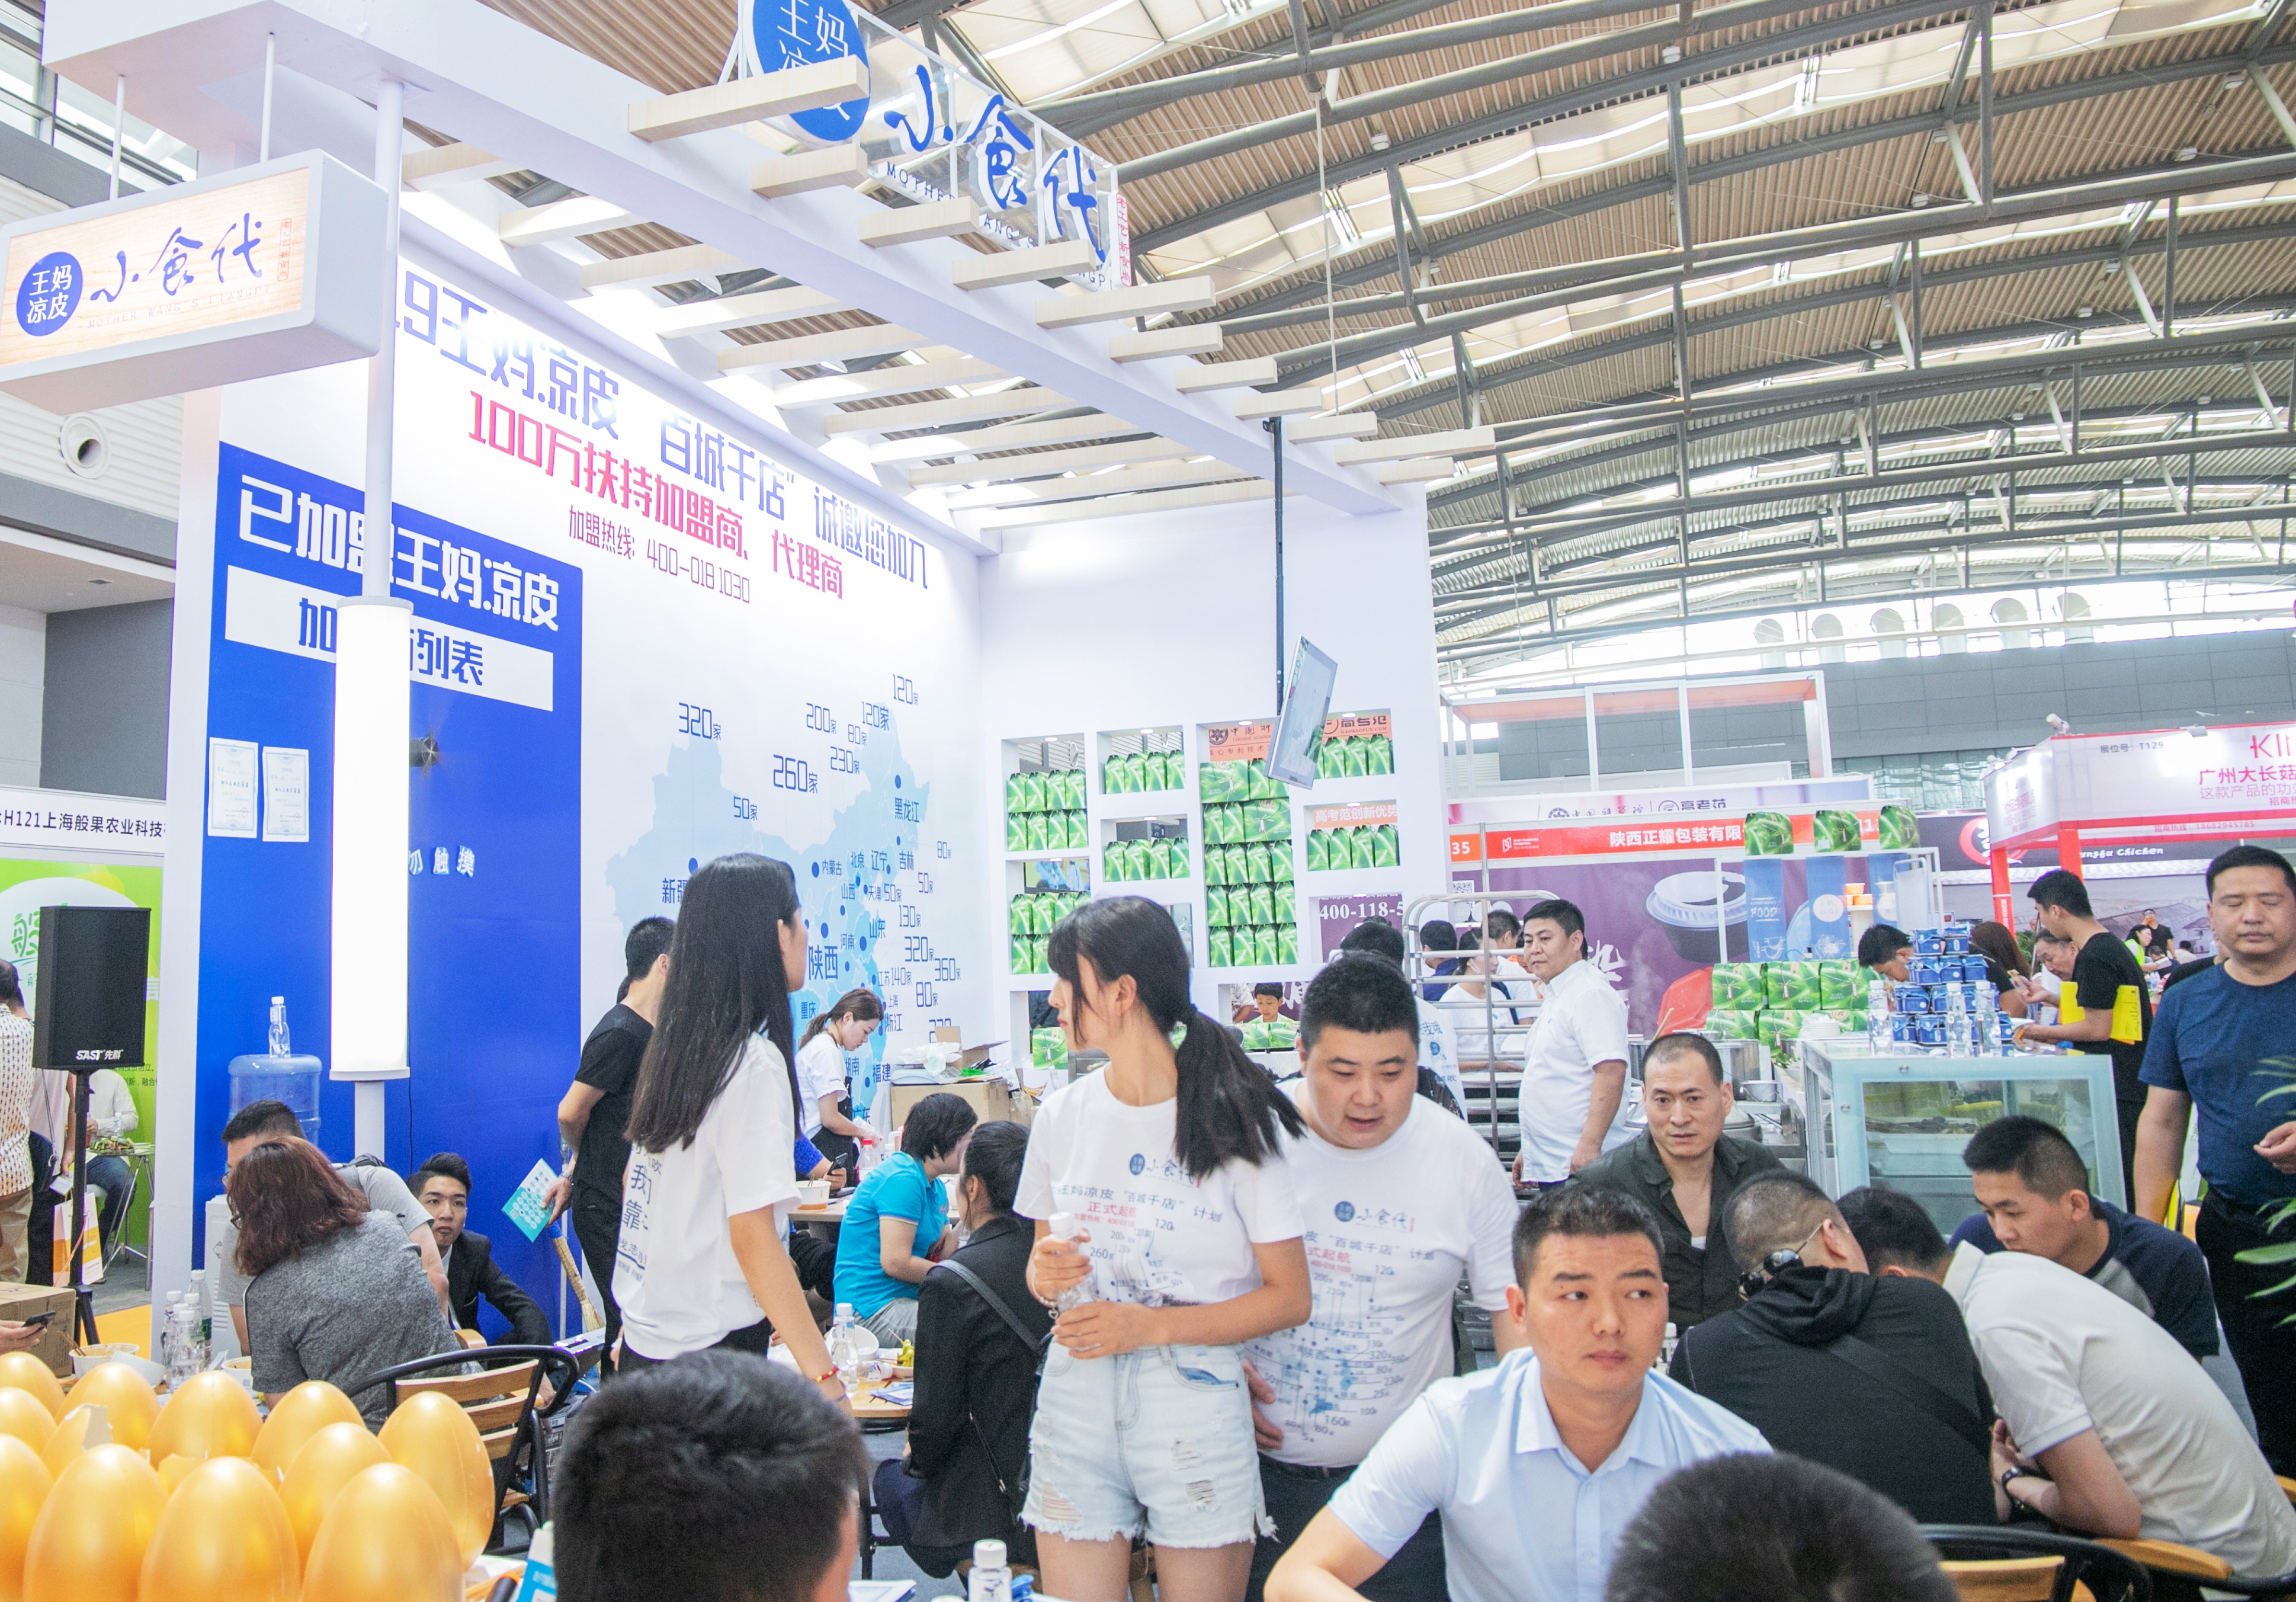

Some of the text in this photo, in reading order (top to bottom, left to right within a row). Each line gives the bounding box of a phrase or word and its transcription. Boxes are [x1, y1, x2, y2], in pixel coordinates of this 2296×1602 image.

[884, 64, 1106, 263] 小食代
[90, 212, 262, 303] 小食代
[29, 264, 72, 297] 王妈
[27, 291, 69, 324] 凉皮
[88, 284, 270, 329] MOTHER WANG'S LIANGPI
[298, 597, 483, 686] 加列表
[893, 674, 918, 706] 120家
[678, 702, 721, 741] 320家
[806, 703, 836, 734] 200家
[862, 701, 889, 730] 120家
[848, 724, 867, 746] 80家
[1341, 726, 1387, 735] GAOKAOFUN.COM
[2138, 741, 2164, 750] T129
[830, 746, 860, 774] 230家
[773, 754, 818, 794] 260家
[733, 796, 758, 821] 50家
[894, 797, 920, 823] 黑龙江
[1609, 824, 1745, 847] 陕西正耀包装有限
[851, 851, 865, 869] 北京
[871, 850, 887, 872] 辽宁
[899, 850, 915, 872] 吉林
[2080, 847, 2164, 860] ungfu Chicken
[822, 859, 842, 876] 内蒙古
[841, 883, 855, 900] 山西
[868, 883, 902, 902] 天津 50家
[918, 872, 934, 894] 50家
[899, 905, 921, 928] 130家
[1750, 906, 1777, 918] FOOD
[869, 918, 886, 939] 山东
[841, 933, 855, 950] 河南
[904, 936, 934, 962] 320家
[808, 945, 839, 981] 陕西
[934, 957, 961, 982] 360家
[916, 981, 938, 1007] 80家
[801, 1001, 817, 1020] 重庆
[76, 1049, 102, 1060] SAST
[873, 1063, 892, 1084] 福建
